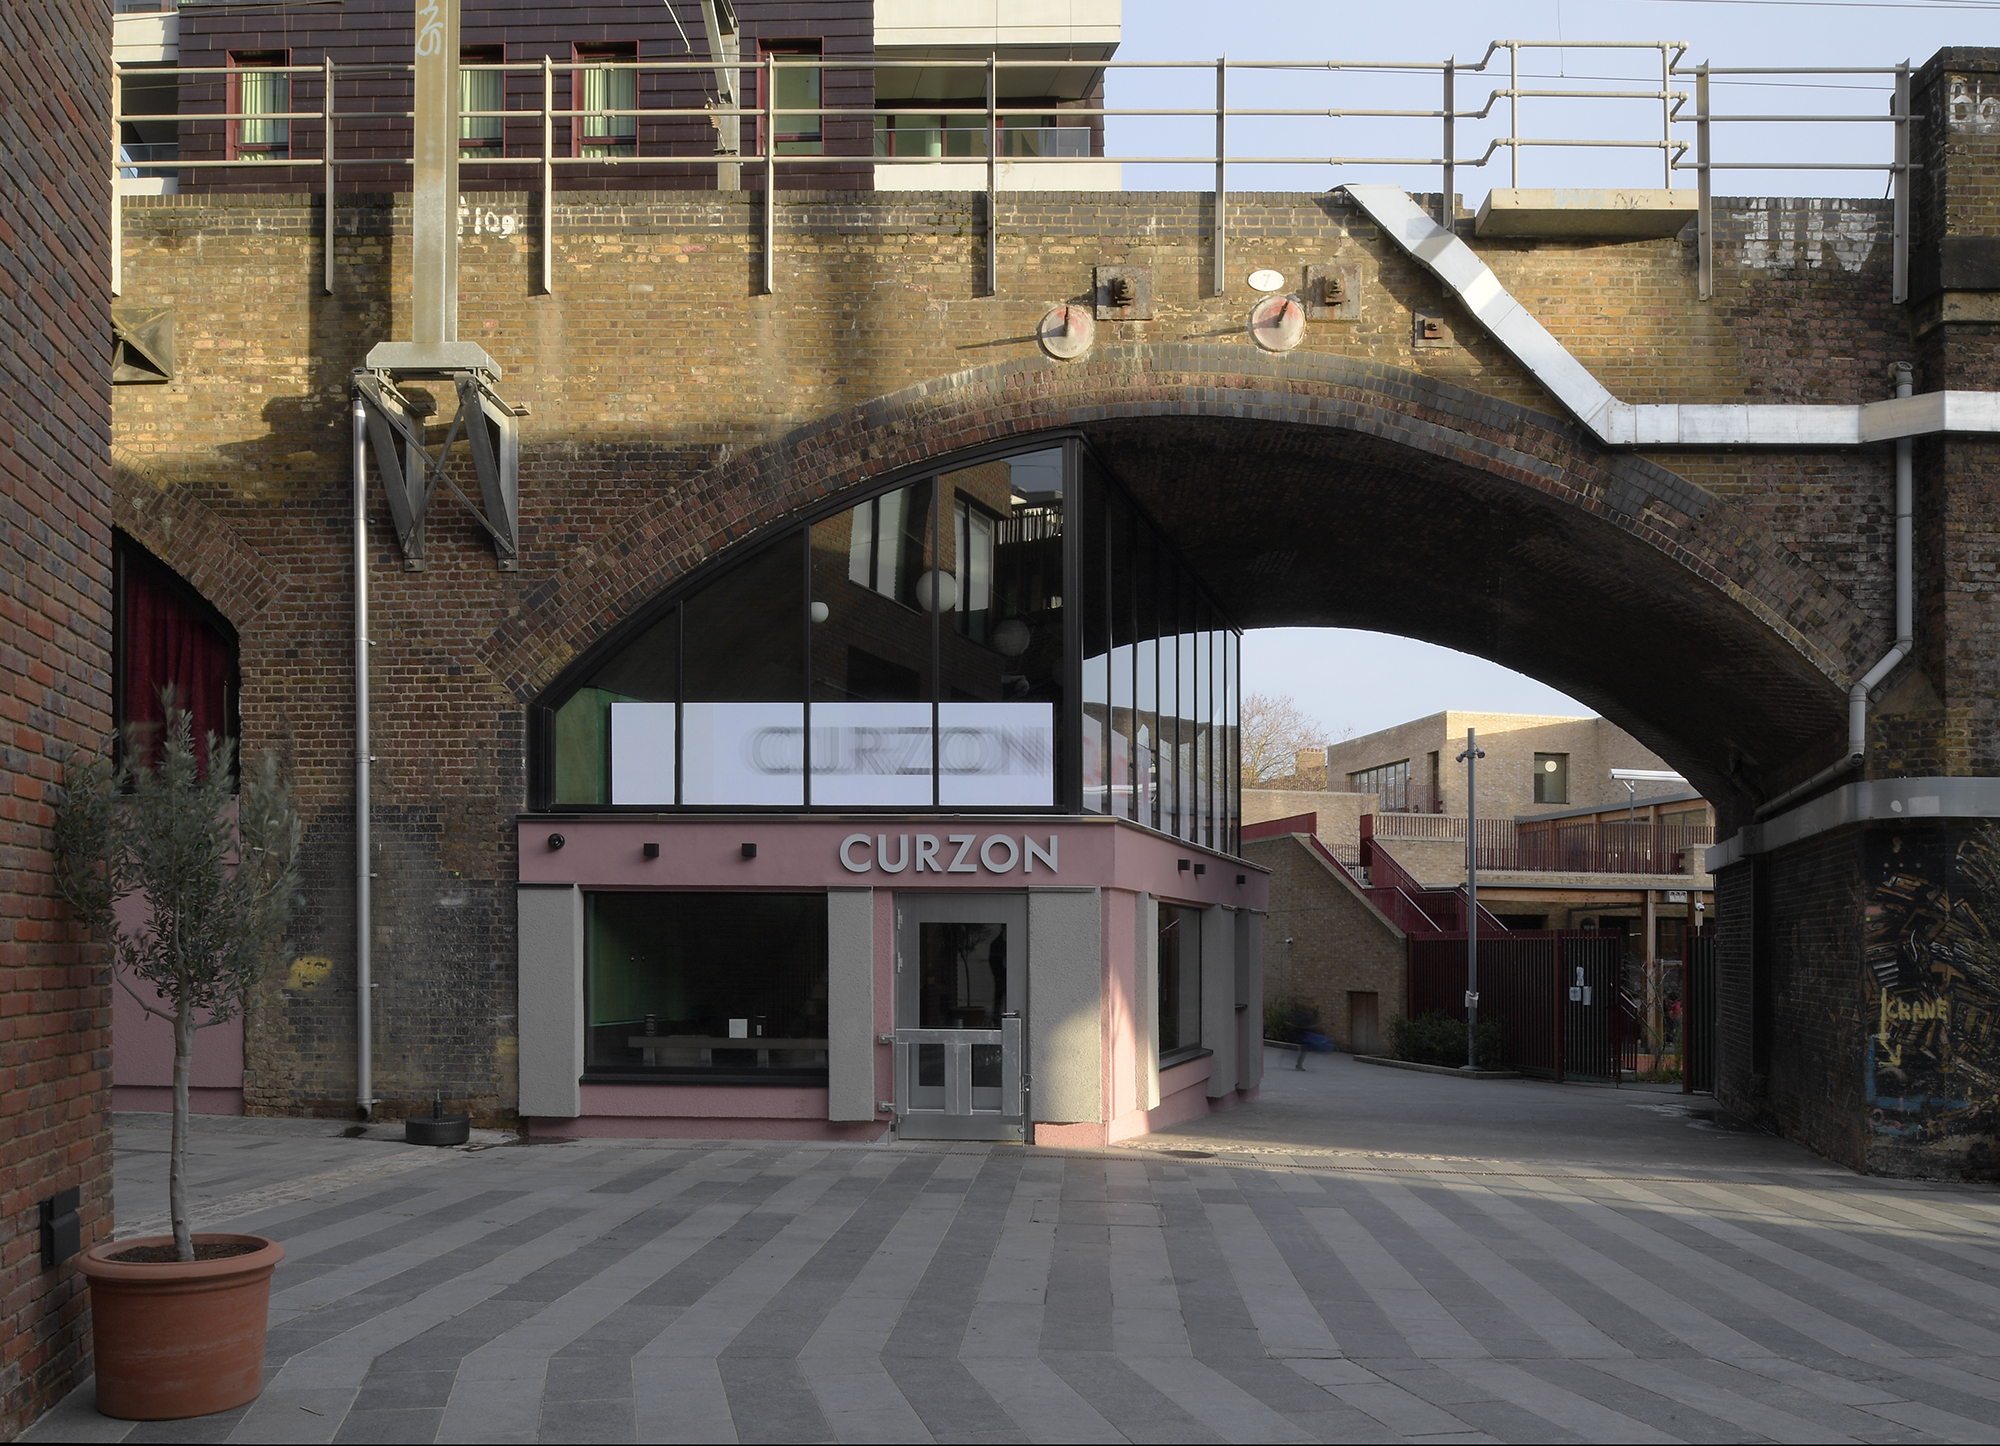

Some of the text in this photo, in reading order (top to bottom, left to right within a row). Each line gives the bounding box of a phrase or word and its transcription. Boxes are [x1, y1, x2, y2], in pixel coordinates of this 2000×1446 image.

[1262, 273, 1271, 287] 7
[742, 725, 1052, 777] CURZON
[839, 833, 1058, 873] CURZON
[1887, 998, 1948, 1023] CRANE
